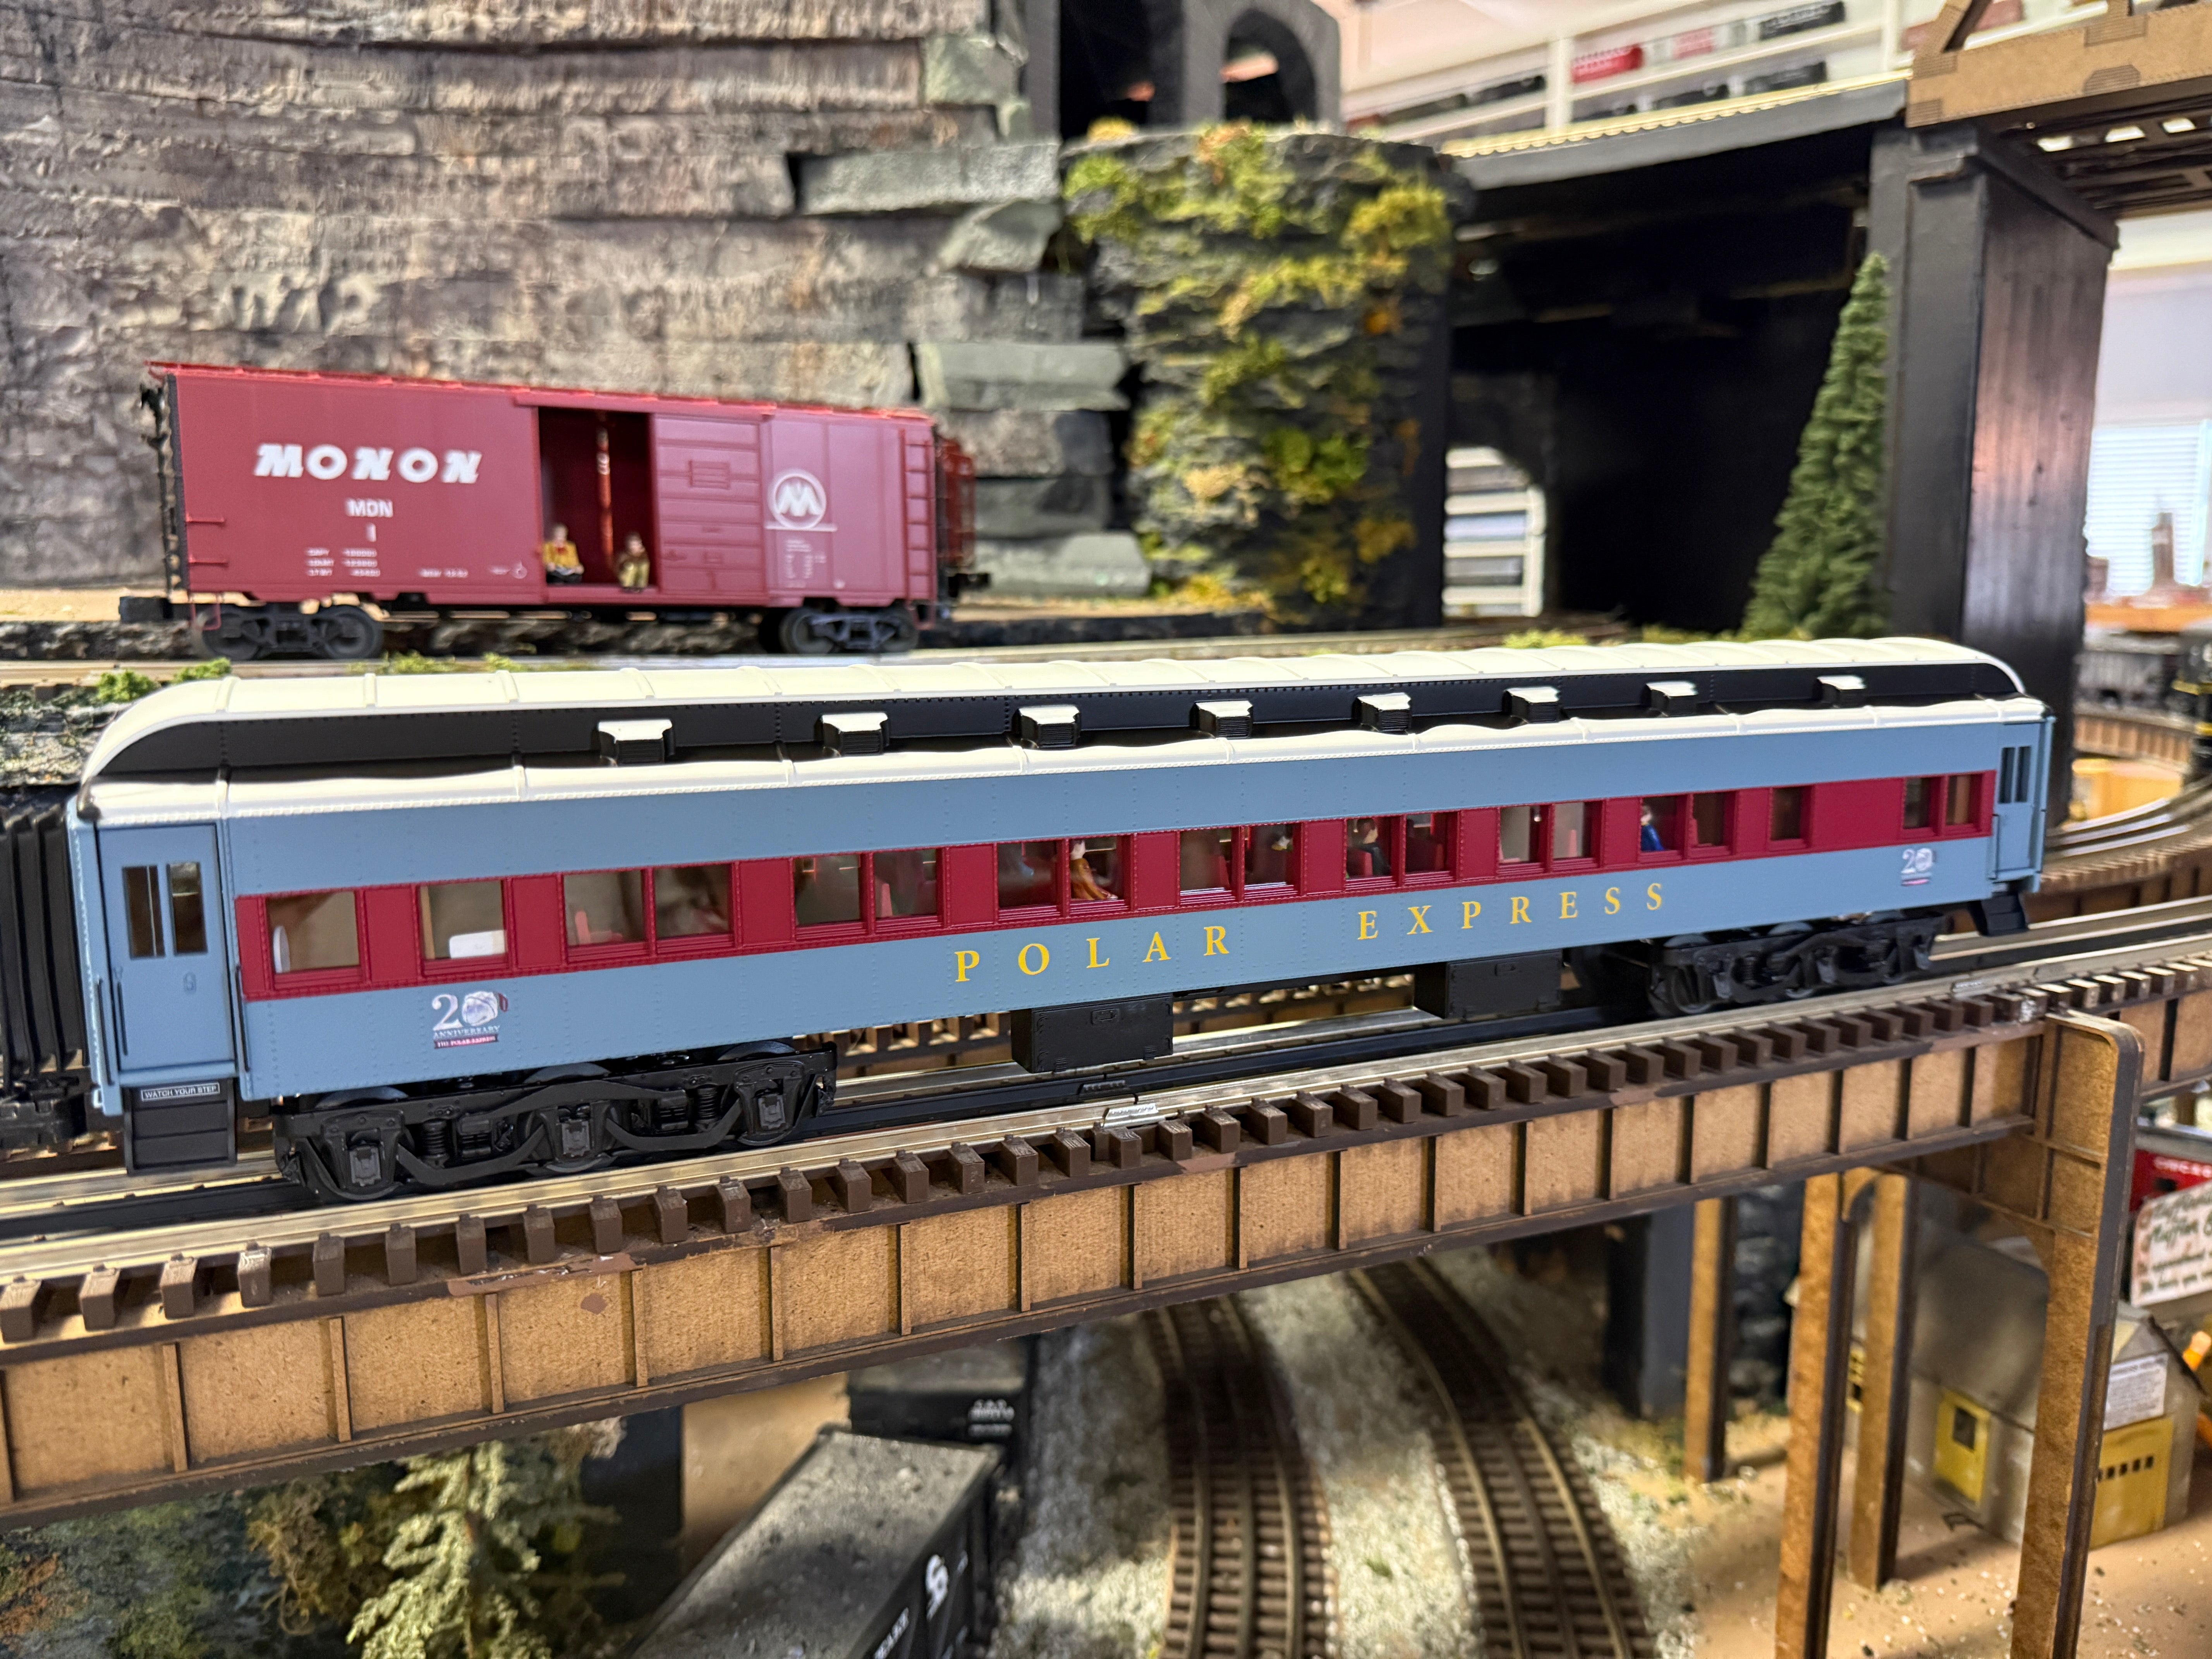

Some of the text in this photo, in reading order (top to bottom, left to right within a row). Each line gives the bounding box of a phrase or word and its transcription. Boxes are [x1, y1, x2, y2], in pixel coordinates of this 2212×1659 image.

[254, 443, 482, 484] MONON
[954, 883, 1662, 982] POLAR EXPRESS
[144, 1085, 217, 1099] WATCH YOUR STEP
